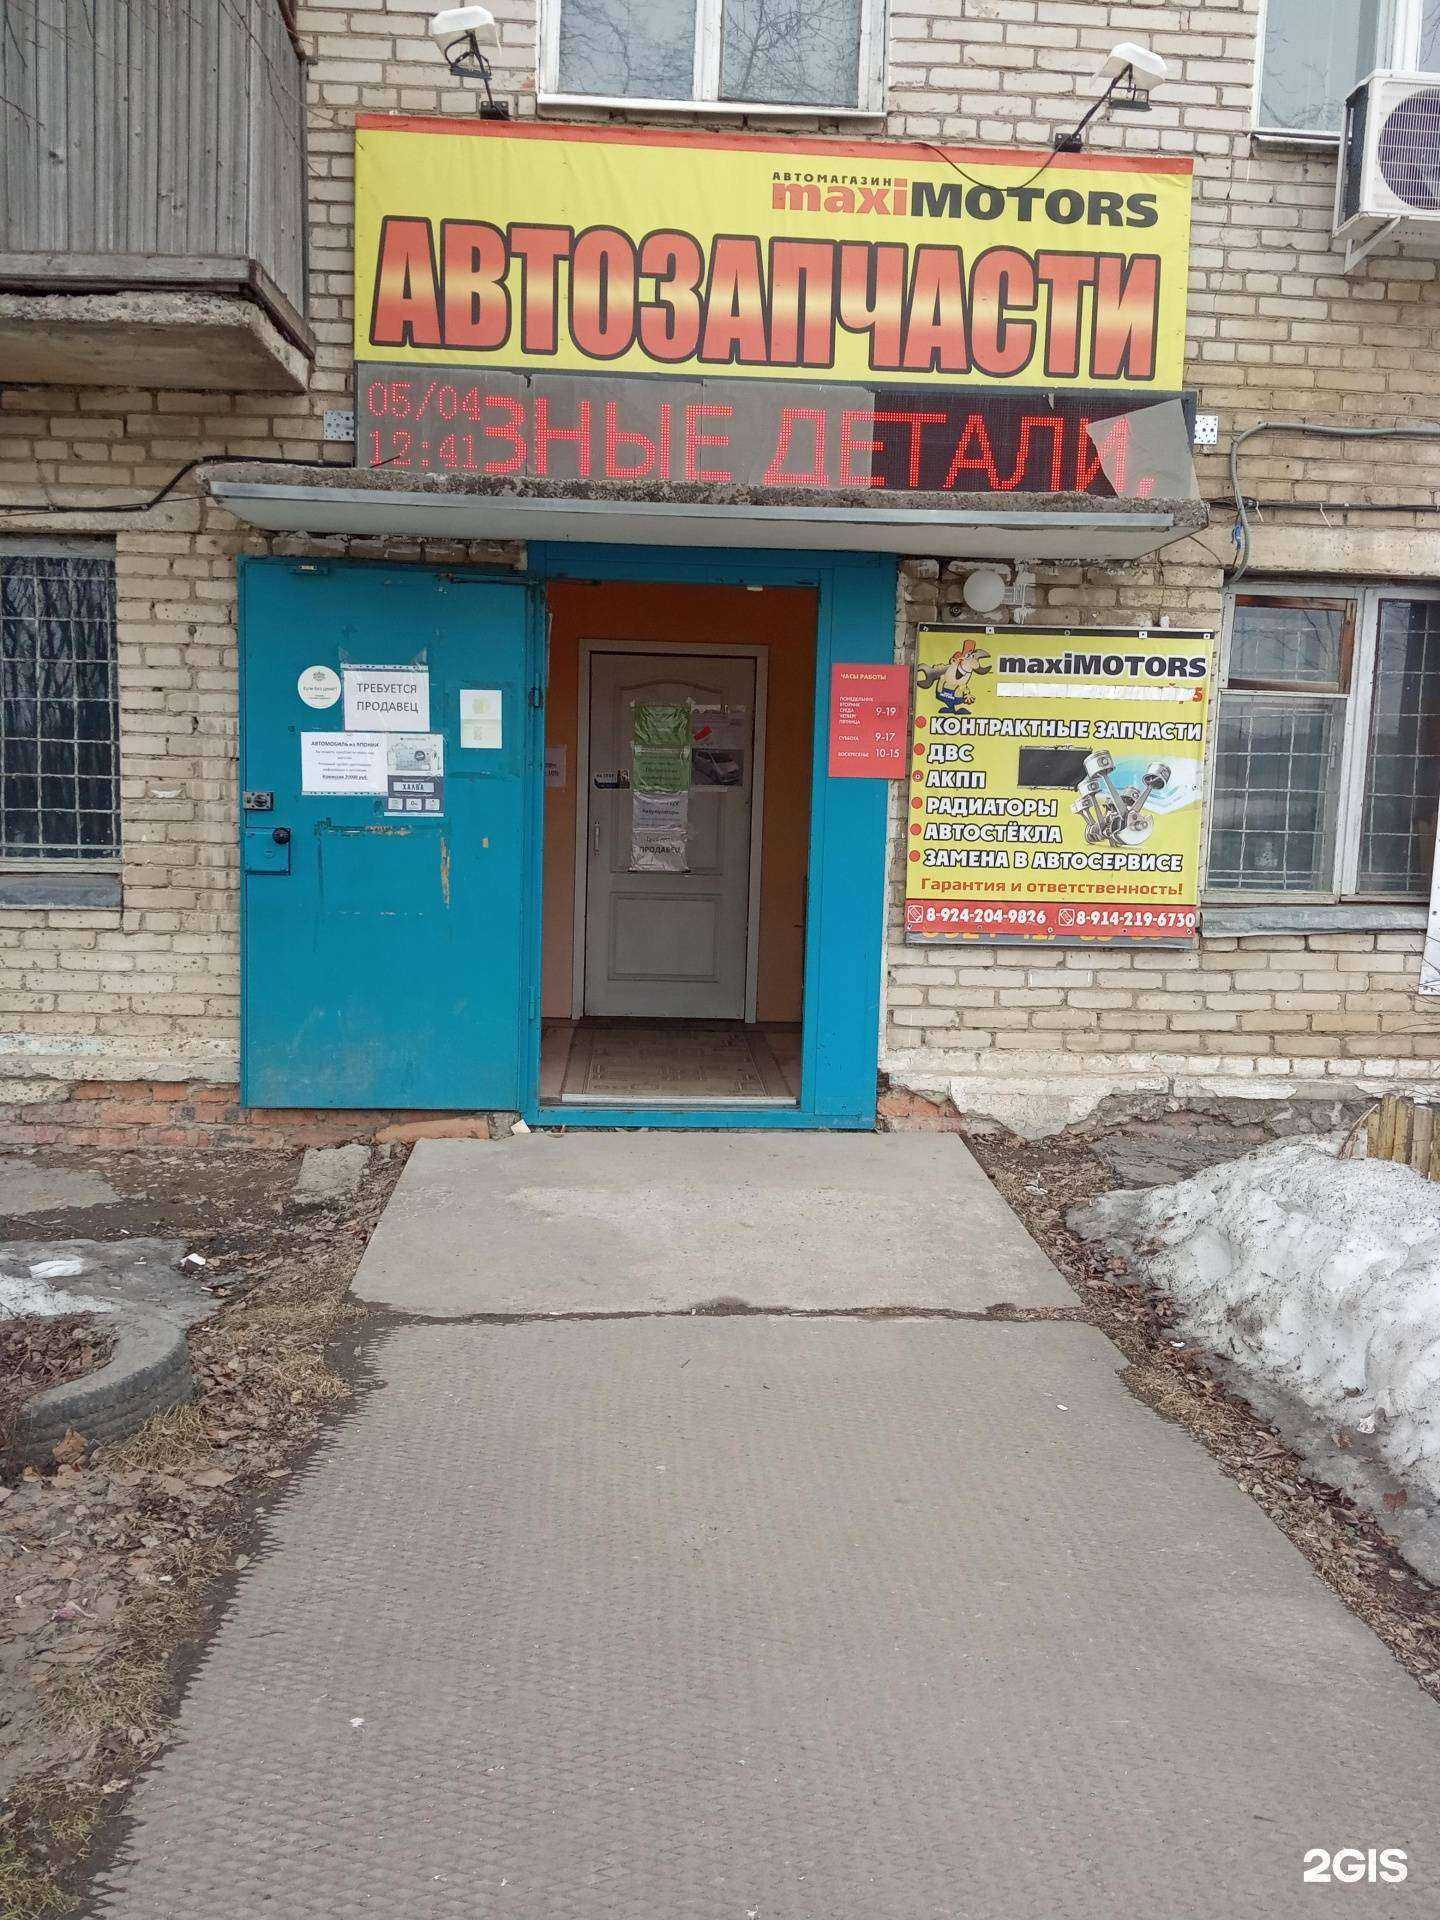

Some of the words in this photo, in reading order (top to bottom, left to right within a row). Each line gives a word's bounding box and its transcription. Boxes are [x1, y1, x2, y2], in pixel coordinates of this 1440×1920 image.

[772, 171, 892, 186] АВТОМАГАЗИН
[771, 177, 1159, 228] maxiMOTORS
[369, 214, 1161, 381] АВТОЗАПЧАСТИ
[367, 381, 481, 422] 05/04
[368, 430, 478, 469] 12:41
[484, 395, 734, 484] ЗНЫЕ
[999, 652, 1208, 677] maxiMOTORS
[356, 682, 417, 694] ТРЕБУЕТСЯ
[356, 701, 419, 714] ПРОДАВЕЦ
[875, 706, 897, 717] 9-19
[874, 732, 896, 742] 9-17
[929, 717, 1090, 739] КОНТРАКТНЫЕ
[1093, 721, 1203, 741] ЗАПЧАСТИ
[875, 748, 900, 758] 10-15
[926, 743, 975, 764] ДВС
[925, 770, 987, 789] АКПП
[925, 797, 1058, 818] РАДИАТОРЫ
[923, 822, 1063, 844] АВТОСТЁКЛА
[923, 849, 1010, 868] ЗАМЕНА
[1013, 851, 1030, 869] В
[1032, 853, 1183, 872] АВТОСЕРВИСЕ
[921, 878, 1006, 893] Гарантия
[1010, 882, 1022, 892] и
[1026, 882, 1183, 895] ответственность!
[926, 907, 1047, 925] 8-924-204-9826
